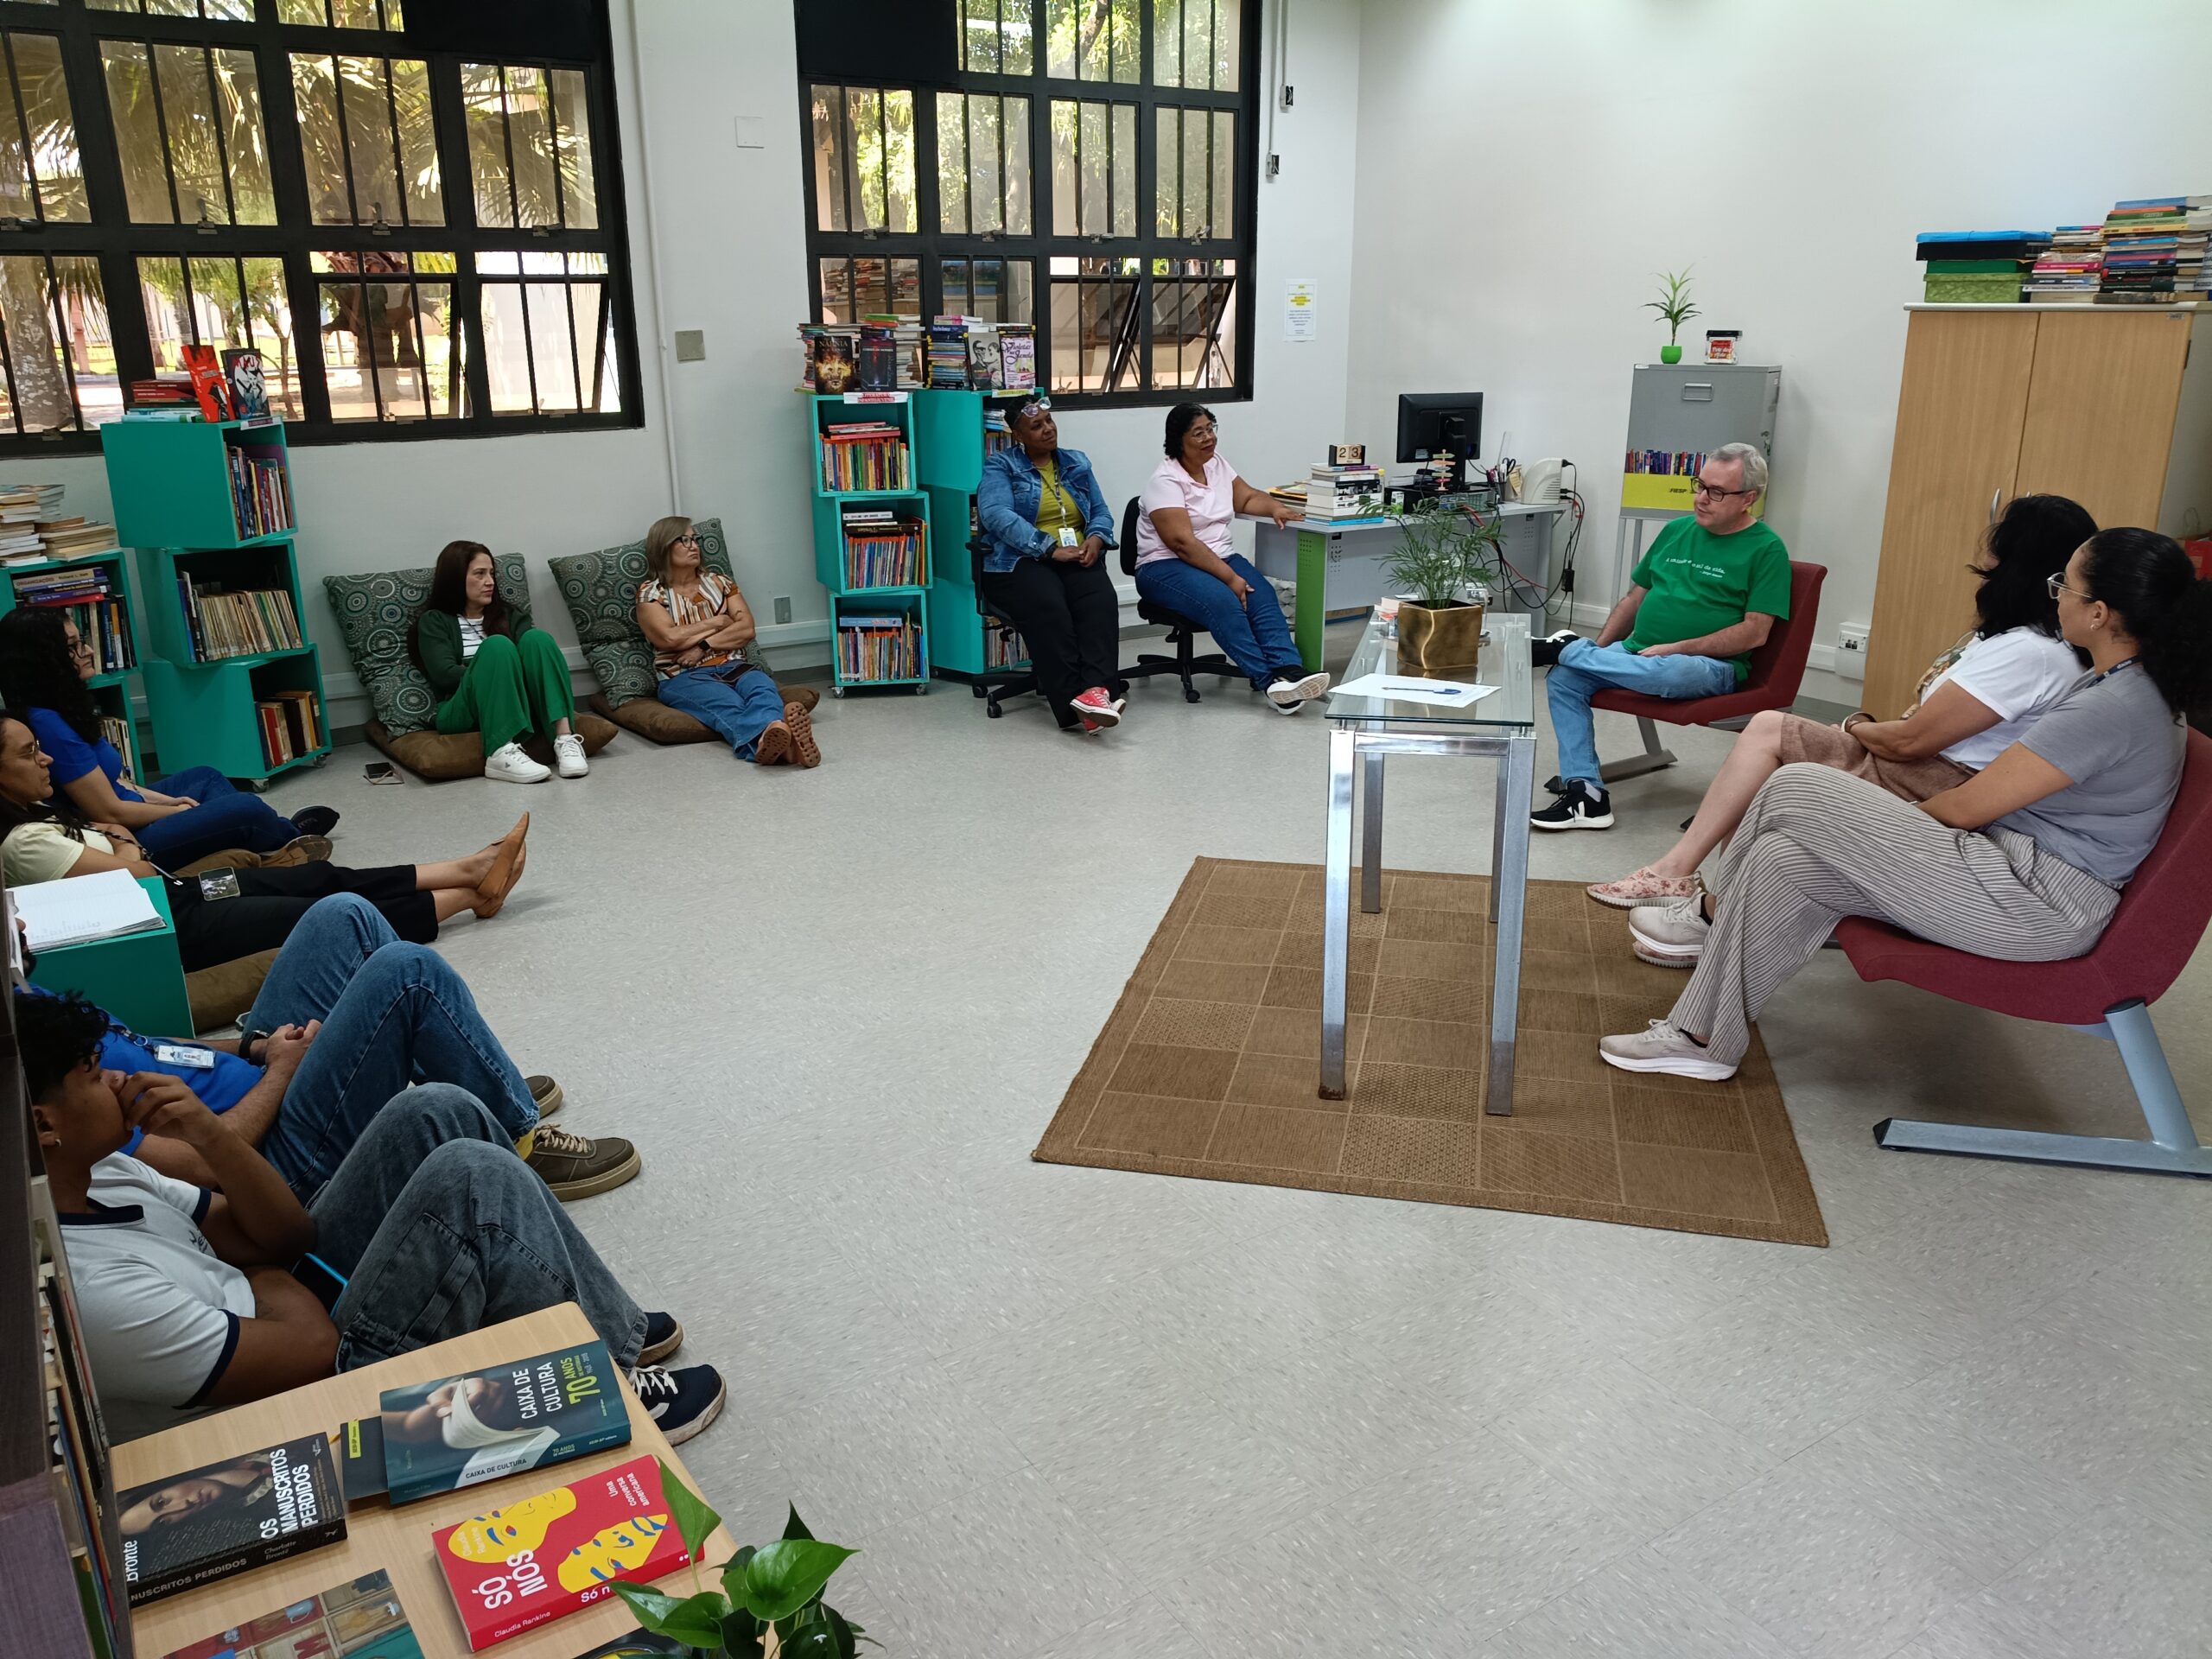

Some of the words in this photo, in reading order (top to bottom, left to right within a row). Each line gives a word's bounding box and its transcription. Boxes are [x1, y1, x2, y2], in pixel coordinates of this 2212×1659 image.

[512, 1368, 531, 1385] DE
[560, 1357, 577, 1380] ANOS
[537, 1361, 563, 1413] CULTURA
[566, 1376, 601, 1405] 70
[516, 1384, 538, 1420] CAIXA
[465, 1468, 486, 1479] CAIXA
[497, 1458, 527, 1471] CULTURA
[269, 1447, 299, 1535] MANUSCRITOS
[291, 1464, 319, 1529] PERDIDOS
[606, 1480, 619, 1497] Uma
[616, 1477, 638, 1507] conversa
[626, 1472, 650, 1507] americana
[259, 1517, 279, 1540] OS
[264, 1540, 296, 1554] Charlotte
[130, 1574, 192, 1601] NUSCRITOS
[194, 1557, 248, 1581] PERDIDOS
[505, 1548, 549, 1599] NÓS
[471, 1576, 513, 1611] SÓ
[580, 1588, 599, 1604] Só
[494, 1623, 522, 1638] Claudia
[522, 1611, 551, 1627] Rankine
